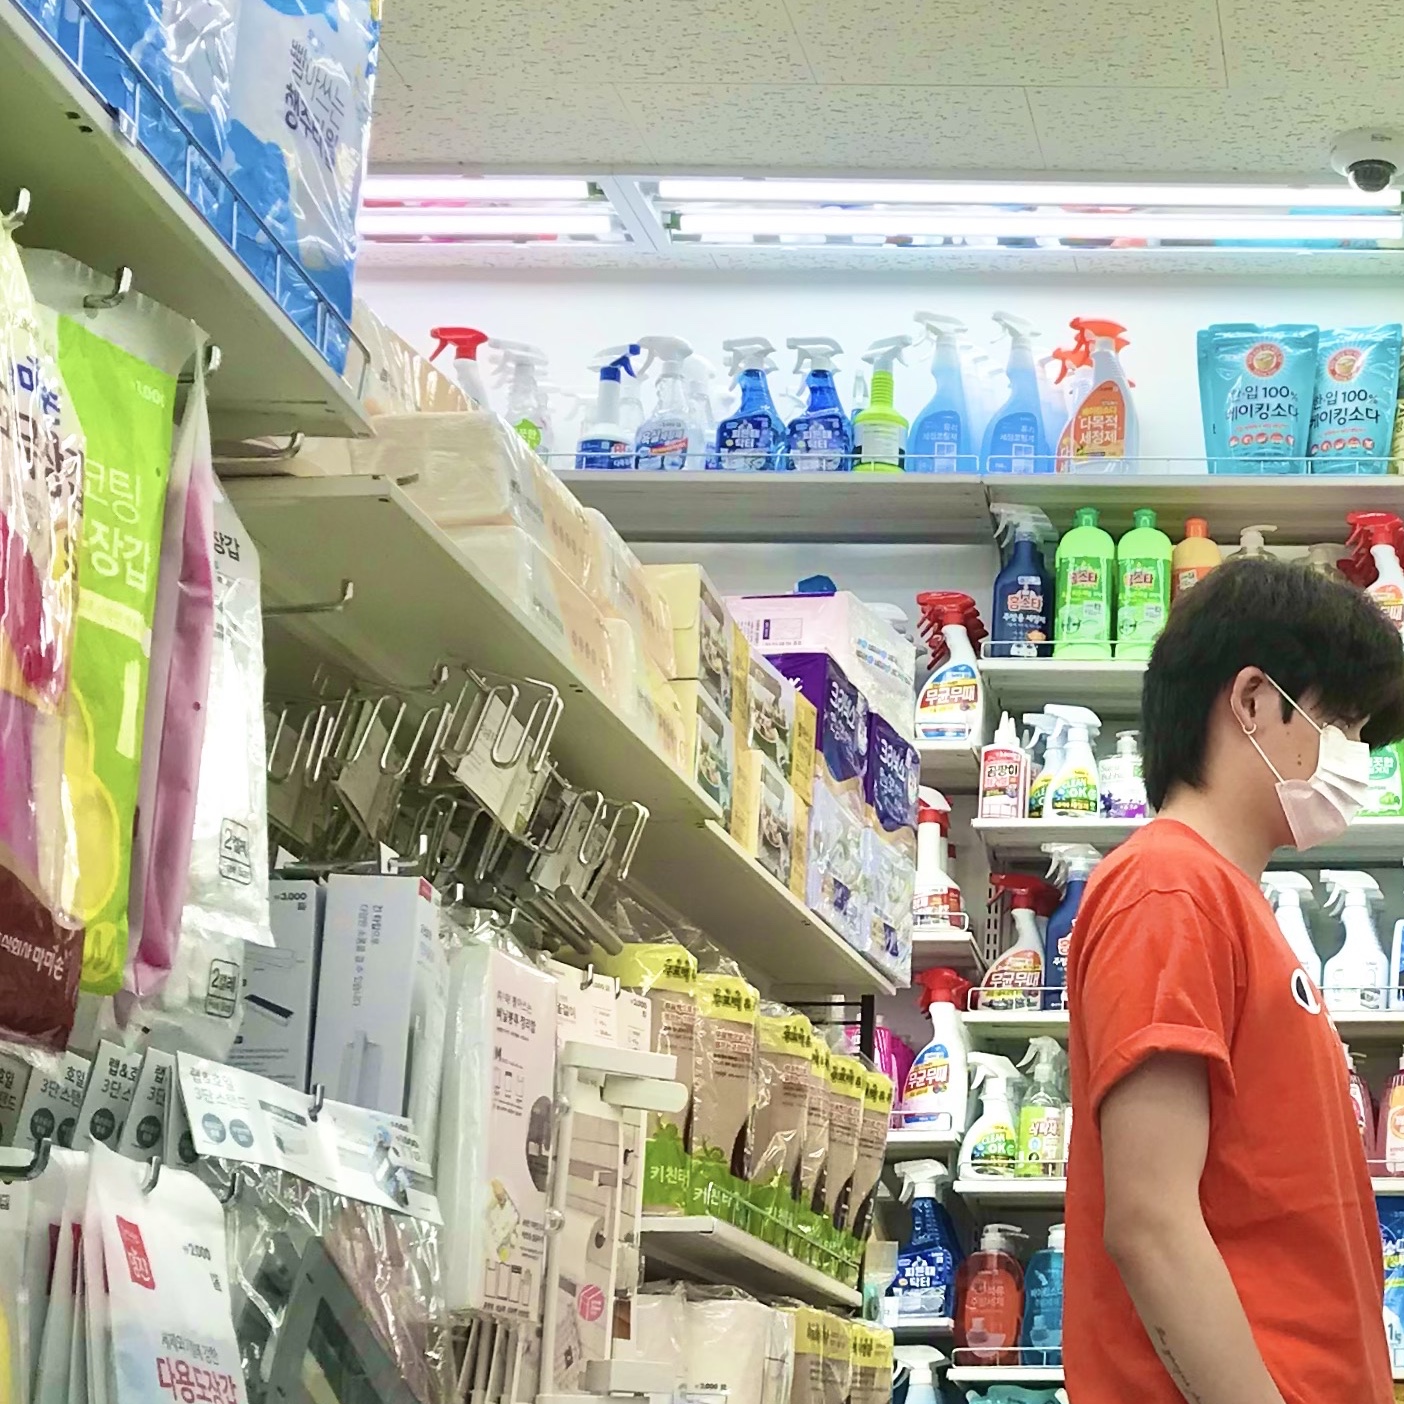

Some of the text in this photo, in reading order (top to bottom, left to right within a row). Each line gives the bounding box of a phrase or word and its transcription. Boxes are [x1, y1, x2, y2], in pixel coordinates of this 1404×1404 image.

[1262, 386, 1298, 400] 100%
[1341, 389, 1379, 405] 100%
[1079, 416, 1118, 430] 다목적
[1079, 430, 1118, 445] 세정제
[83, 520, 151, 594] 장갑
[1007, 596, 1042, 611] 홈스타
[925, 685, 978, 703] 무균무때
[987, 764, 1018, 779] 곰팡이
[33, 946, 65, 982] 마미손
[907, 1066, 950, 1086] 무균무때
